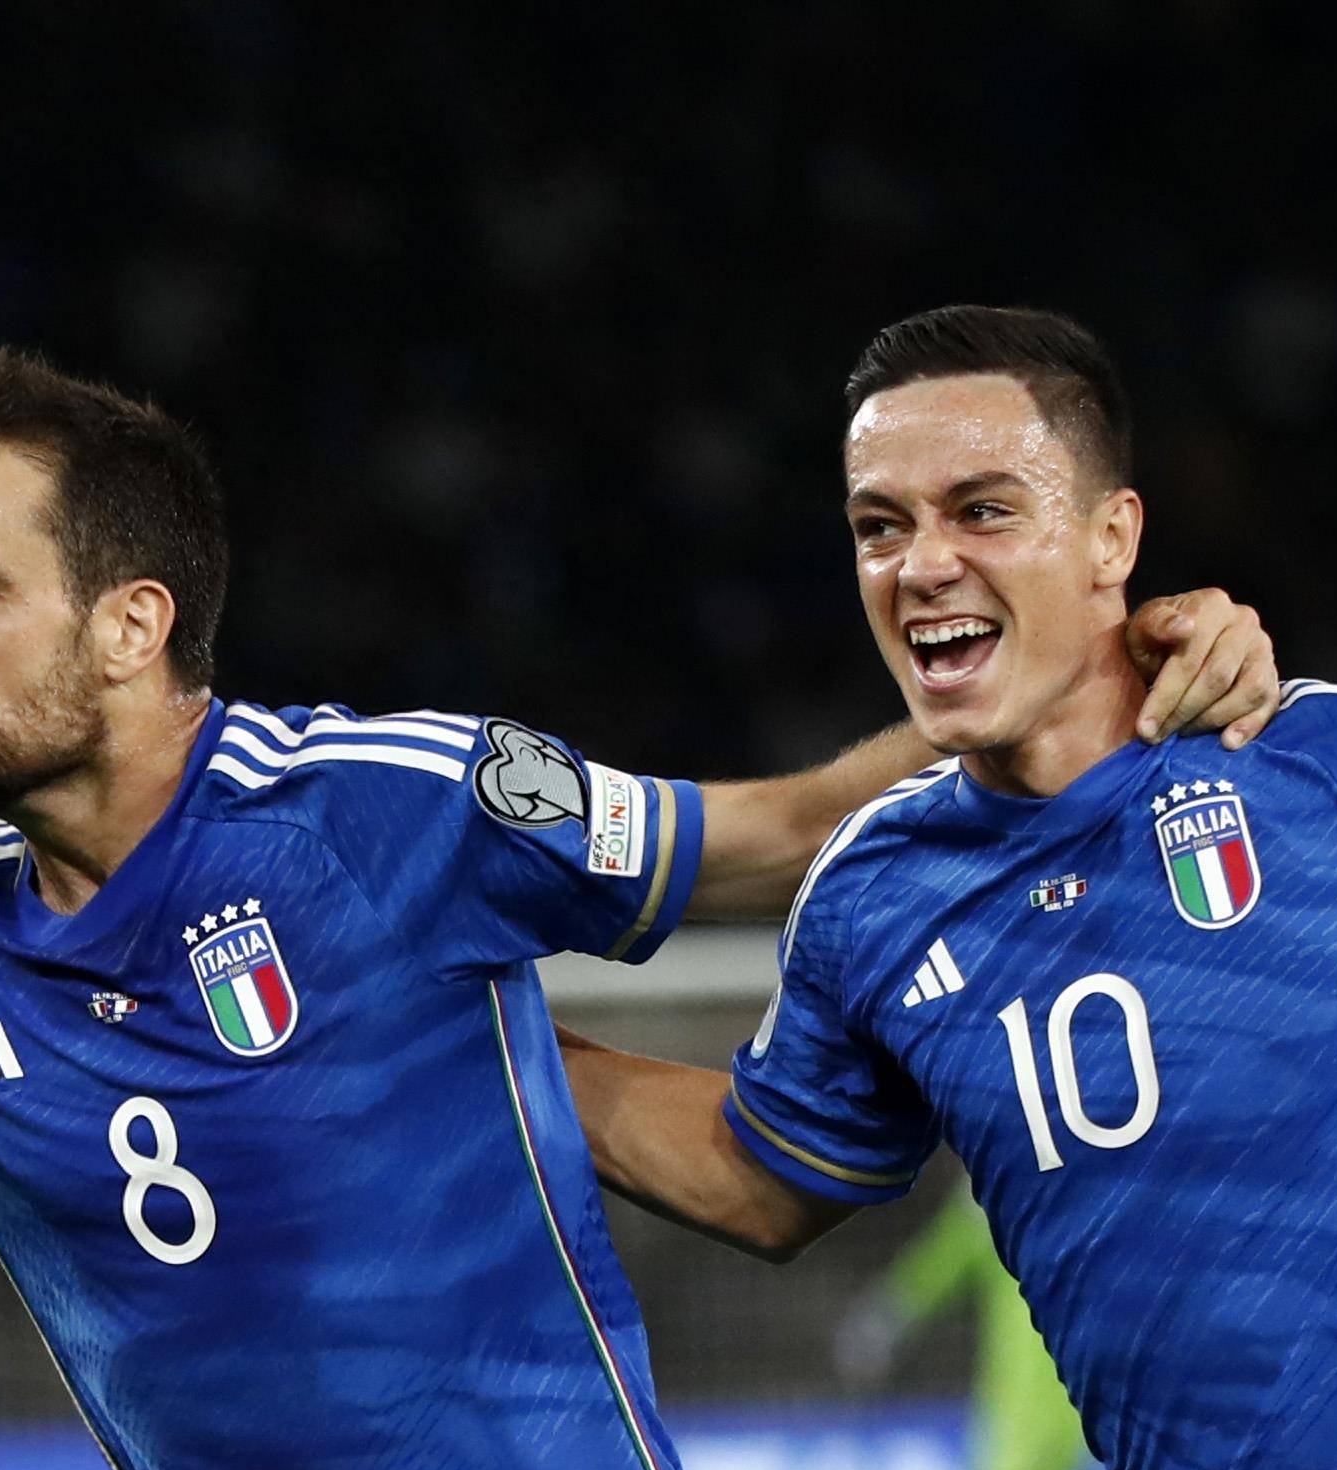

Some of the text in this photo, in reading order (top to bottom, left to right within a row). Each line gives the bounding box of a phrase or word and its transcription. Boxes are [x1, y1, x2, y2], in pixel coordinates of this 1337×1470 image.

[1162, 805, 1238, 848] ITALIA
[196, 929, 268, 979] ITALIA
[997, 972, 1160, 1173] 10
[108, 1095, 217, 1265] 8
